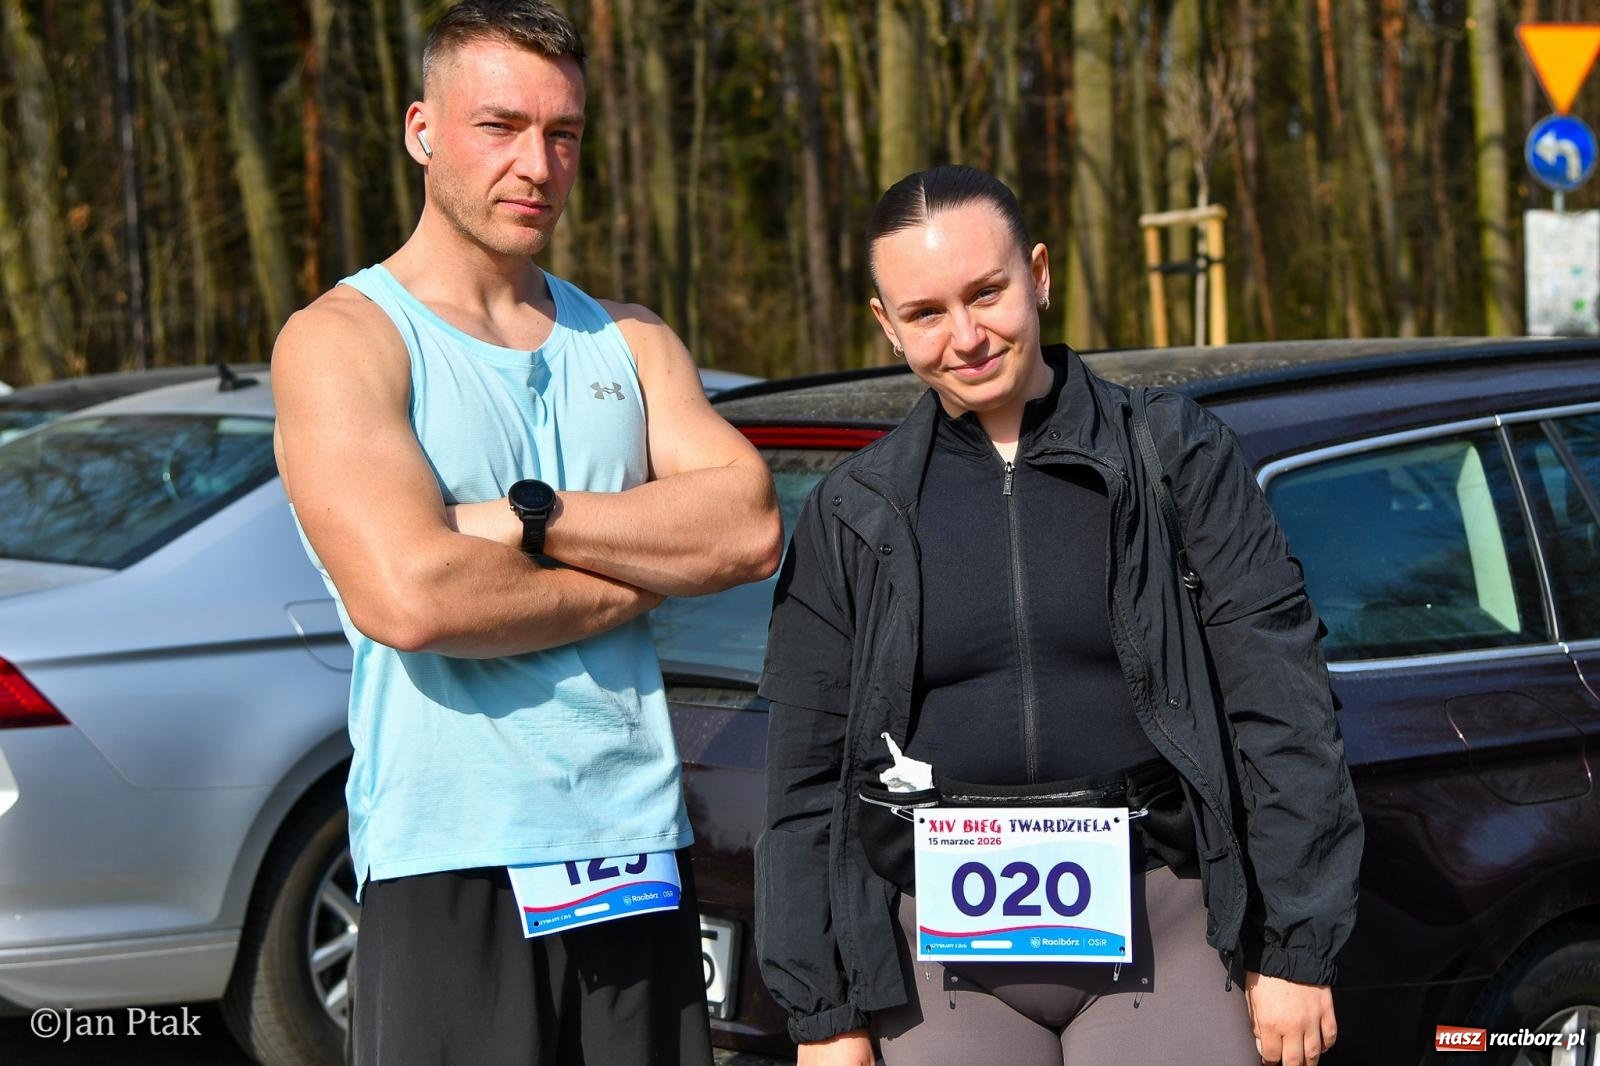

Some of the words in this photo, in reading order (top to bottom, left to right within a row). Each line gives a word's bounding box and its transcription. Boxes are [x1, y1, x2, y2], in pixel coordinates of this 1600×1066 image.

[928, 819, 955, 833] XIV
[963, 819, 1002, 833] BIEG
[1009, 818, 1112, 833] TWARDZIELA
[928, 837, 938, 846] 15
[941, 838, 975, 846] marzec
[977, 837, 1002, 846] 2026
[951, 861, 1092, 917] 020
[1042, 937, 1080, 946] Racibórz
